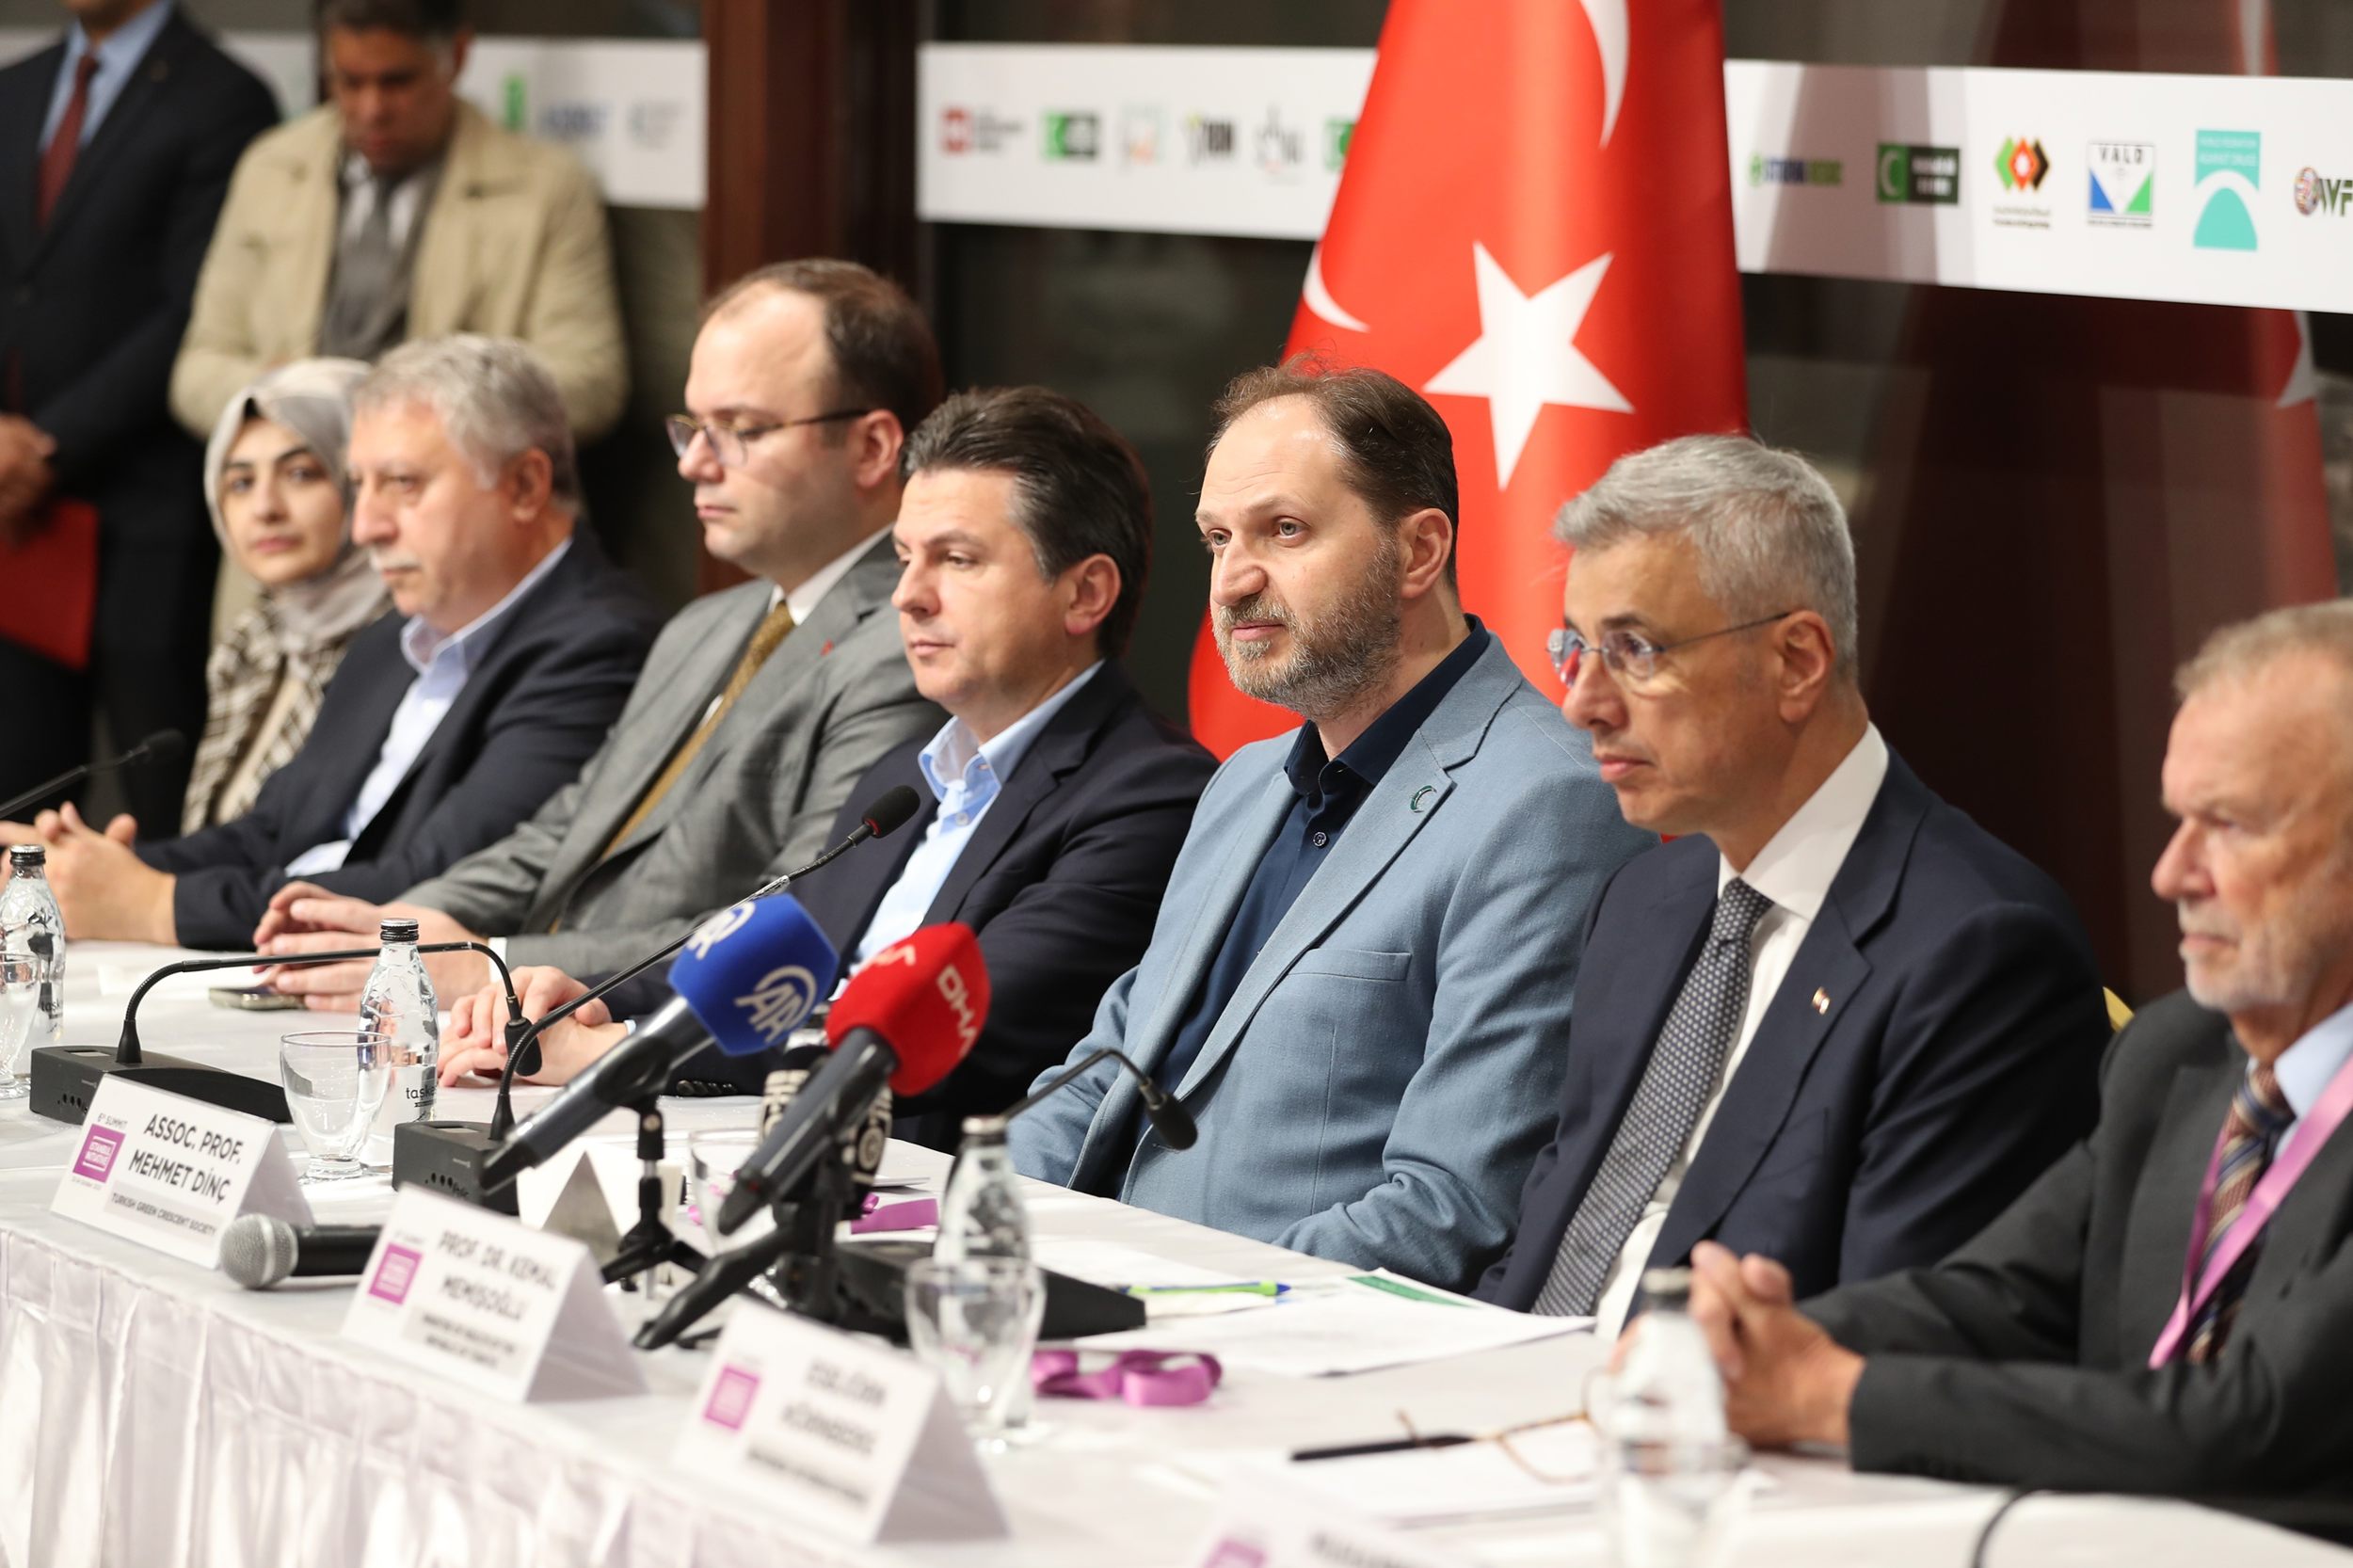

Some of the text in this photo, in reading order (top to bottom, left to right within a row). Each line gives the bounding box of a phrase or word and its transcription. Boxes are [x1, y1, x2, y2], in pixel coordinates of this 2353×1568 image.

[143, 1113, 244, 1164] ASSOC. PROF.
[128, 1148, 194, 1189] MEHMET
[191, 1167, 232, 1205] DİNÇ
[111, 1192, 217, 1237] TURKISH GREEN CRESCENT SOCIETY
